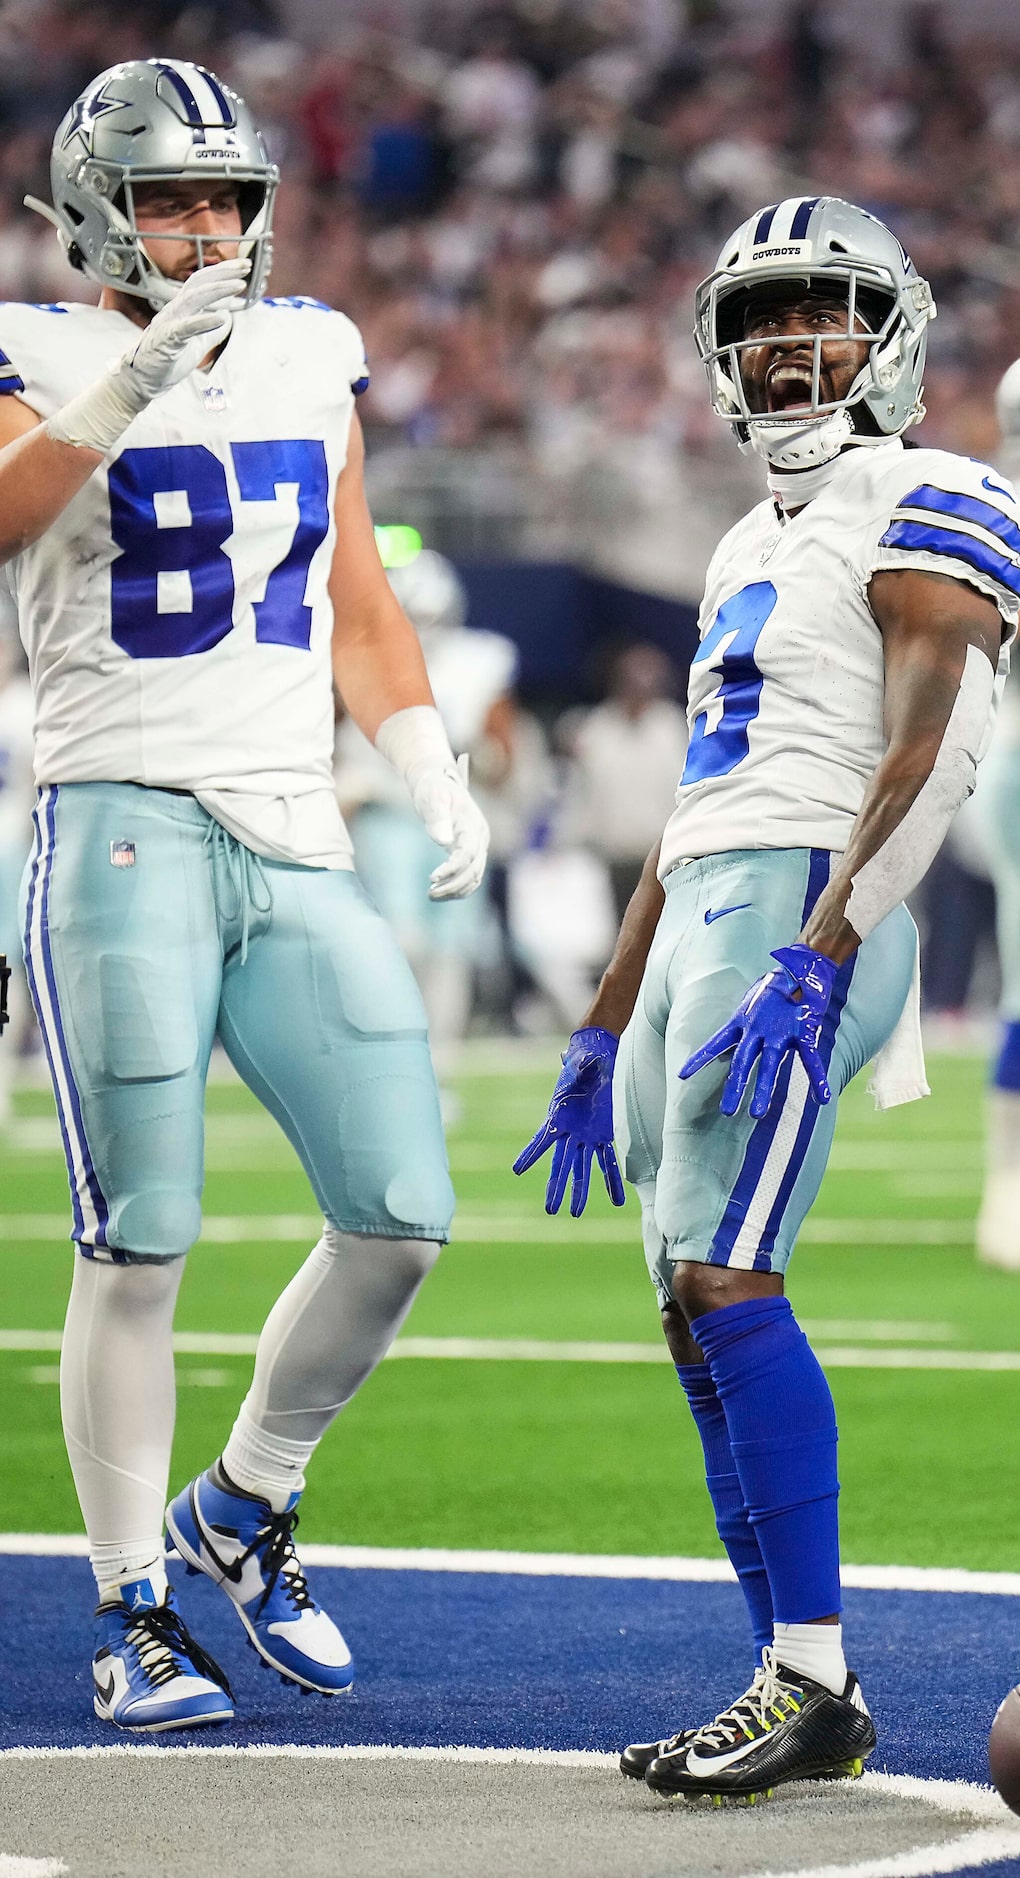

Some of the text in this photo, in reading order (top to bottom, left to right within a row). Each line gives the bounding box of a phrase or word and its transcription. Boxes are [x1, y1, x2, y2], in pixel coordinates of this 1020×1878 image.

[752, 247, 801, 261] COWBOYS
[107, 439, 330, 659] 87
[679, 580, 778, 786] 3
